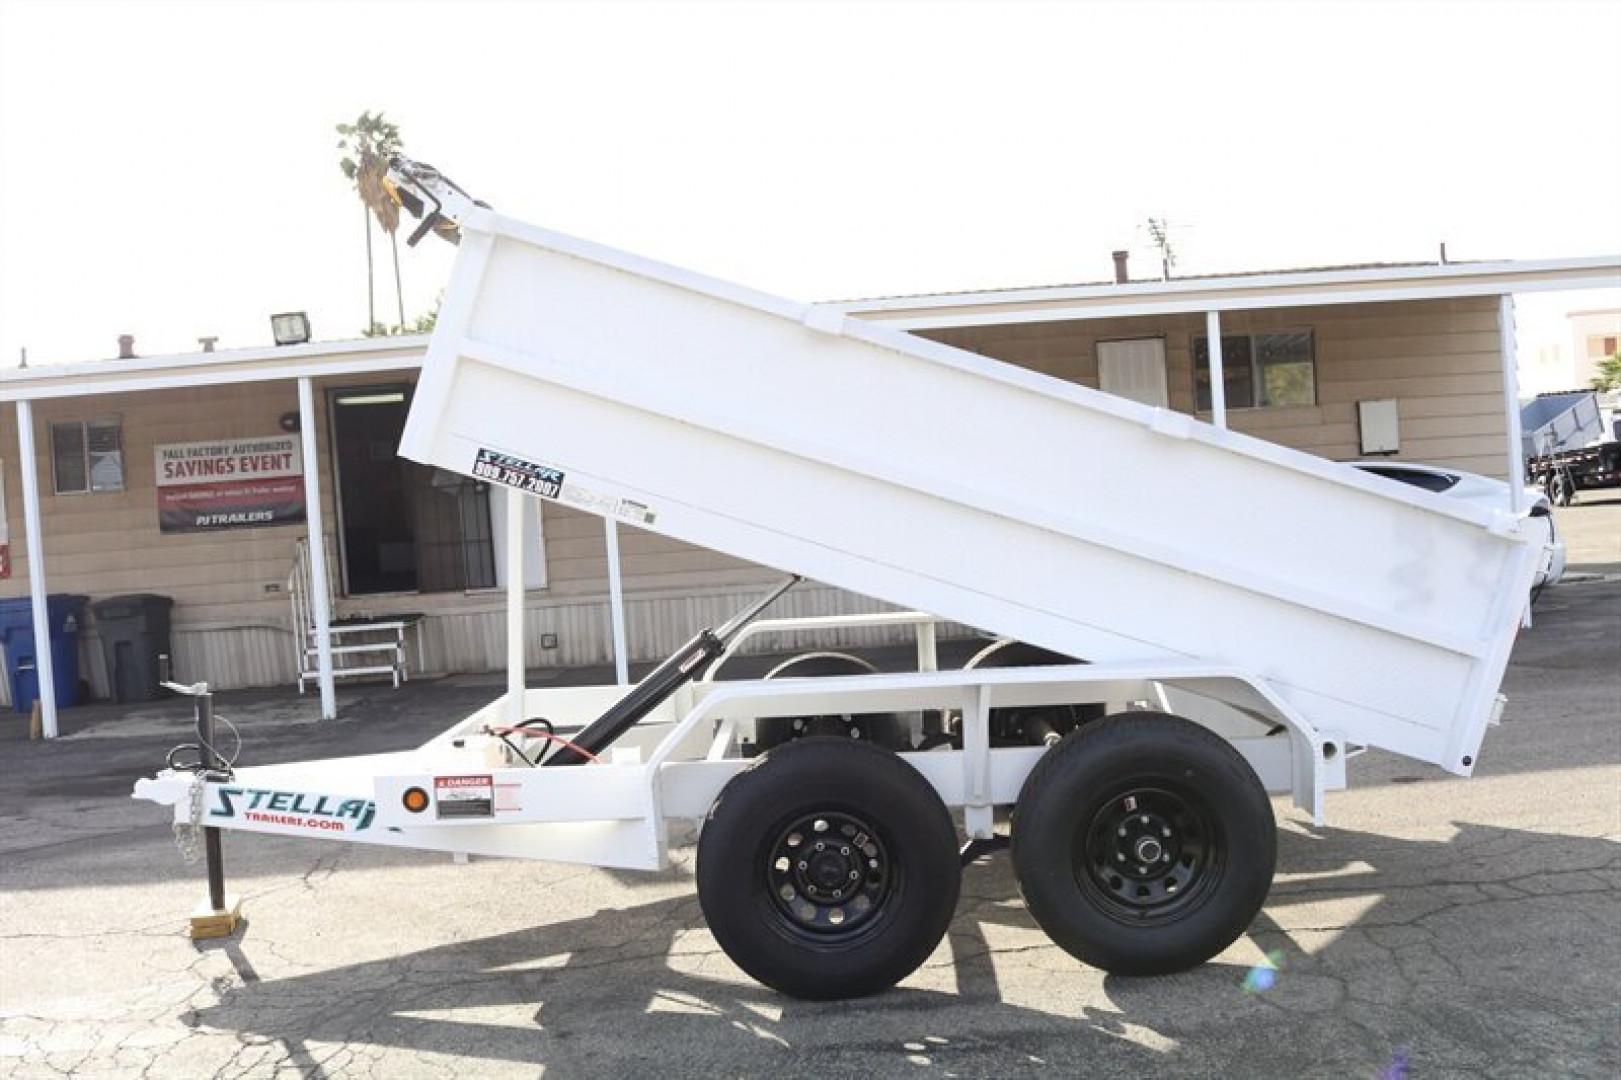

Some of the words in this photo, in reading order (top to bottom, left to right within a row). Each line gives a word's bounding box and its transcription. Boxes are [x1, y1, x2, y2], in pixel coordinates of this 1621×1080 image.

[162, 447, 184, 460] FALL
[187, 445, 230, 457] FACTORY
[232, 440, 293, 455] AUTHORIZED
[164, 457, 236, 479] SAVINGS
[240, 453, 293, 473] EVENT
